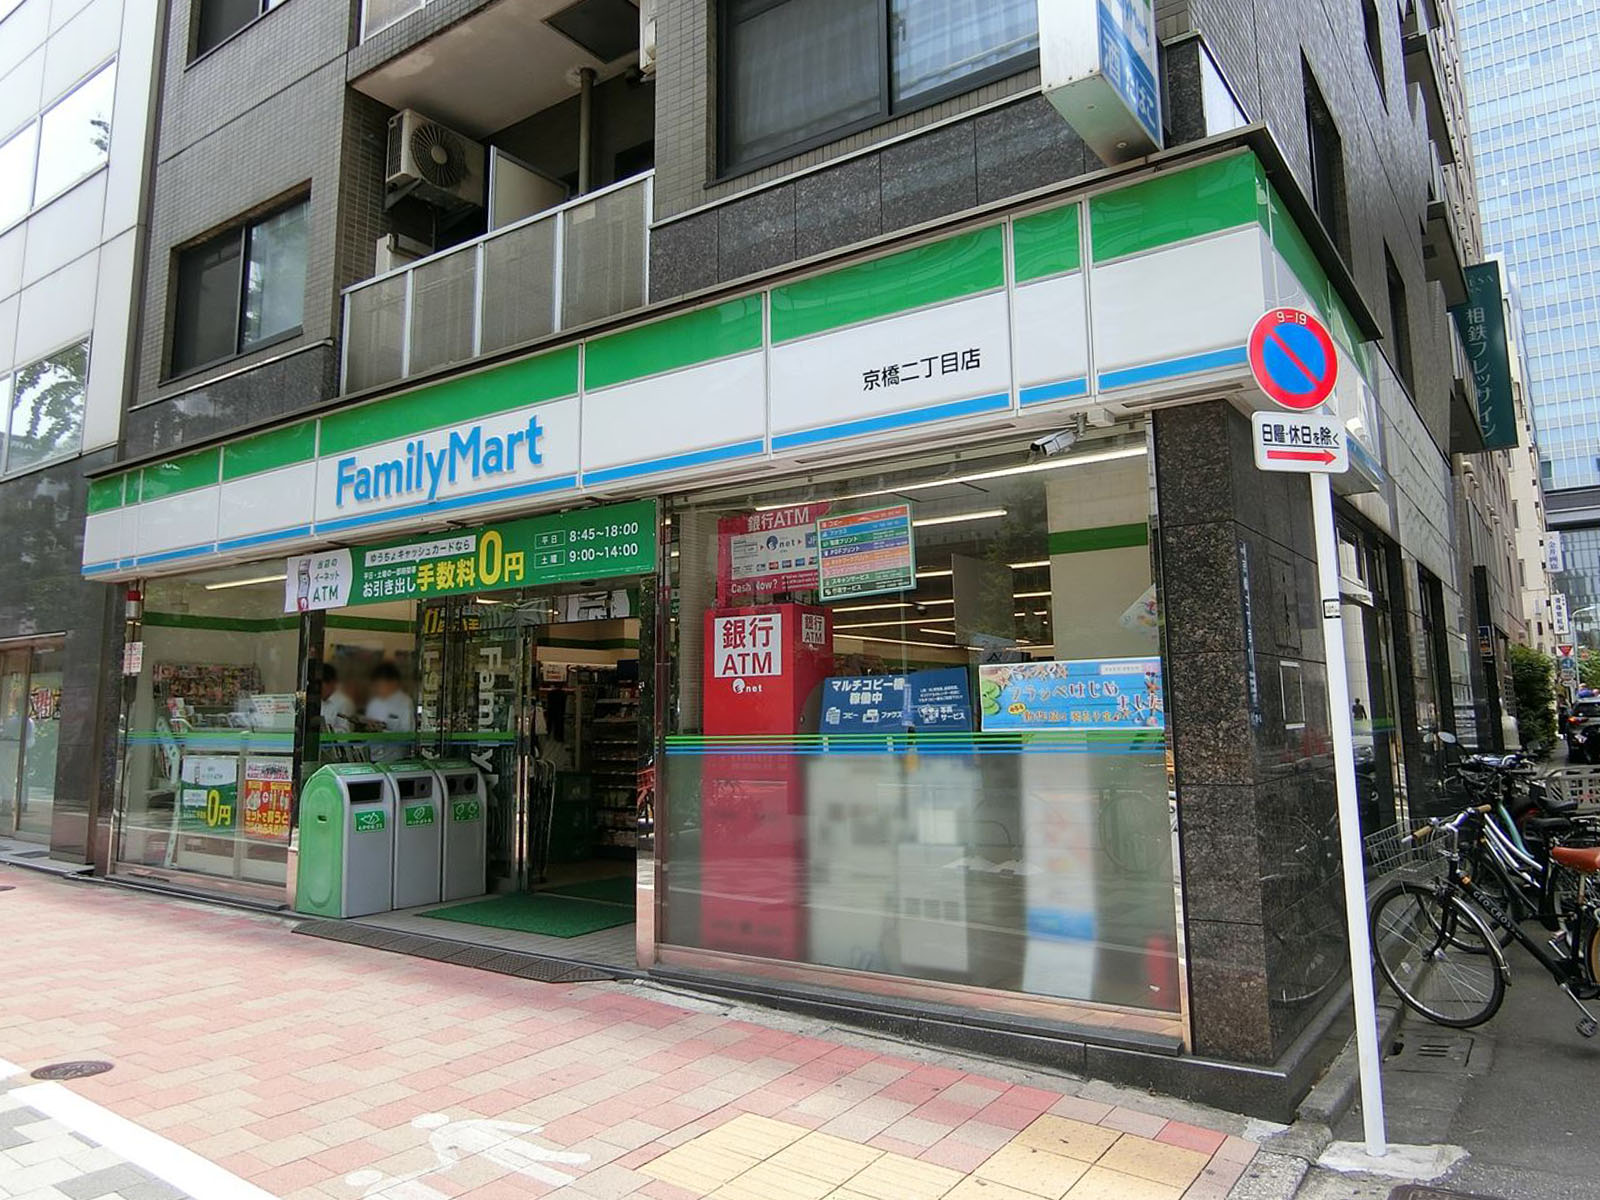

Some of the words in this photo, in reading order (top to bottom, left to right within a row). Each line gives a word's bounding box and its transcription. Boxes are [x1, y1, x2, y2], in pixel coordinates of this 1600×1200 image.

[1276, 311, 1307, 325] 9-19
[862, 348, 981, 391] 京橋二丁目店
[1466, 306, 1496, 438] 相鉄フレッサイン
[336, 415, 543, 507] FamilyMart
[370, 539, 471, 563] ゆうちょキャッシュカードなら
[312, 585, 339, 602] ATM
[363, 577, 416, 597] お引き出し
[722, 617, 774, 649] 銀行
[804, 616, 823, 631] 銀行
[804, 632, 823, 643] ATM
[722, 652, 773, 675] ATM
[842, 710, 859, 719] コピー
[941, 712, 966, 721] サービス
